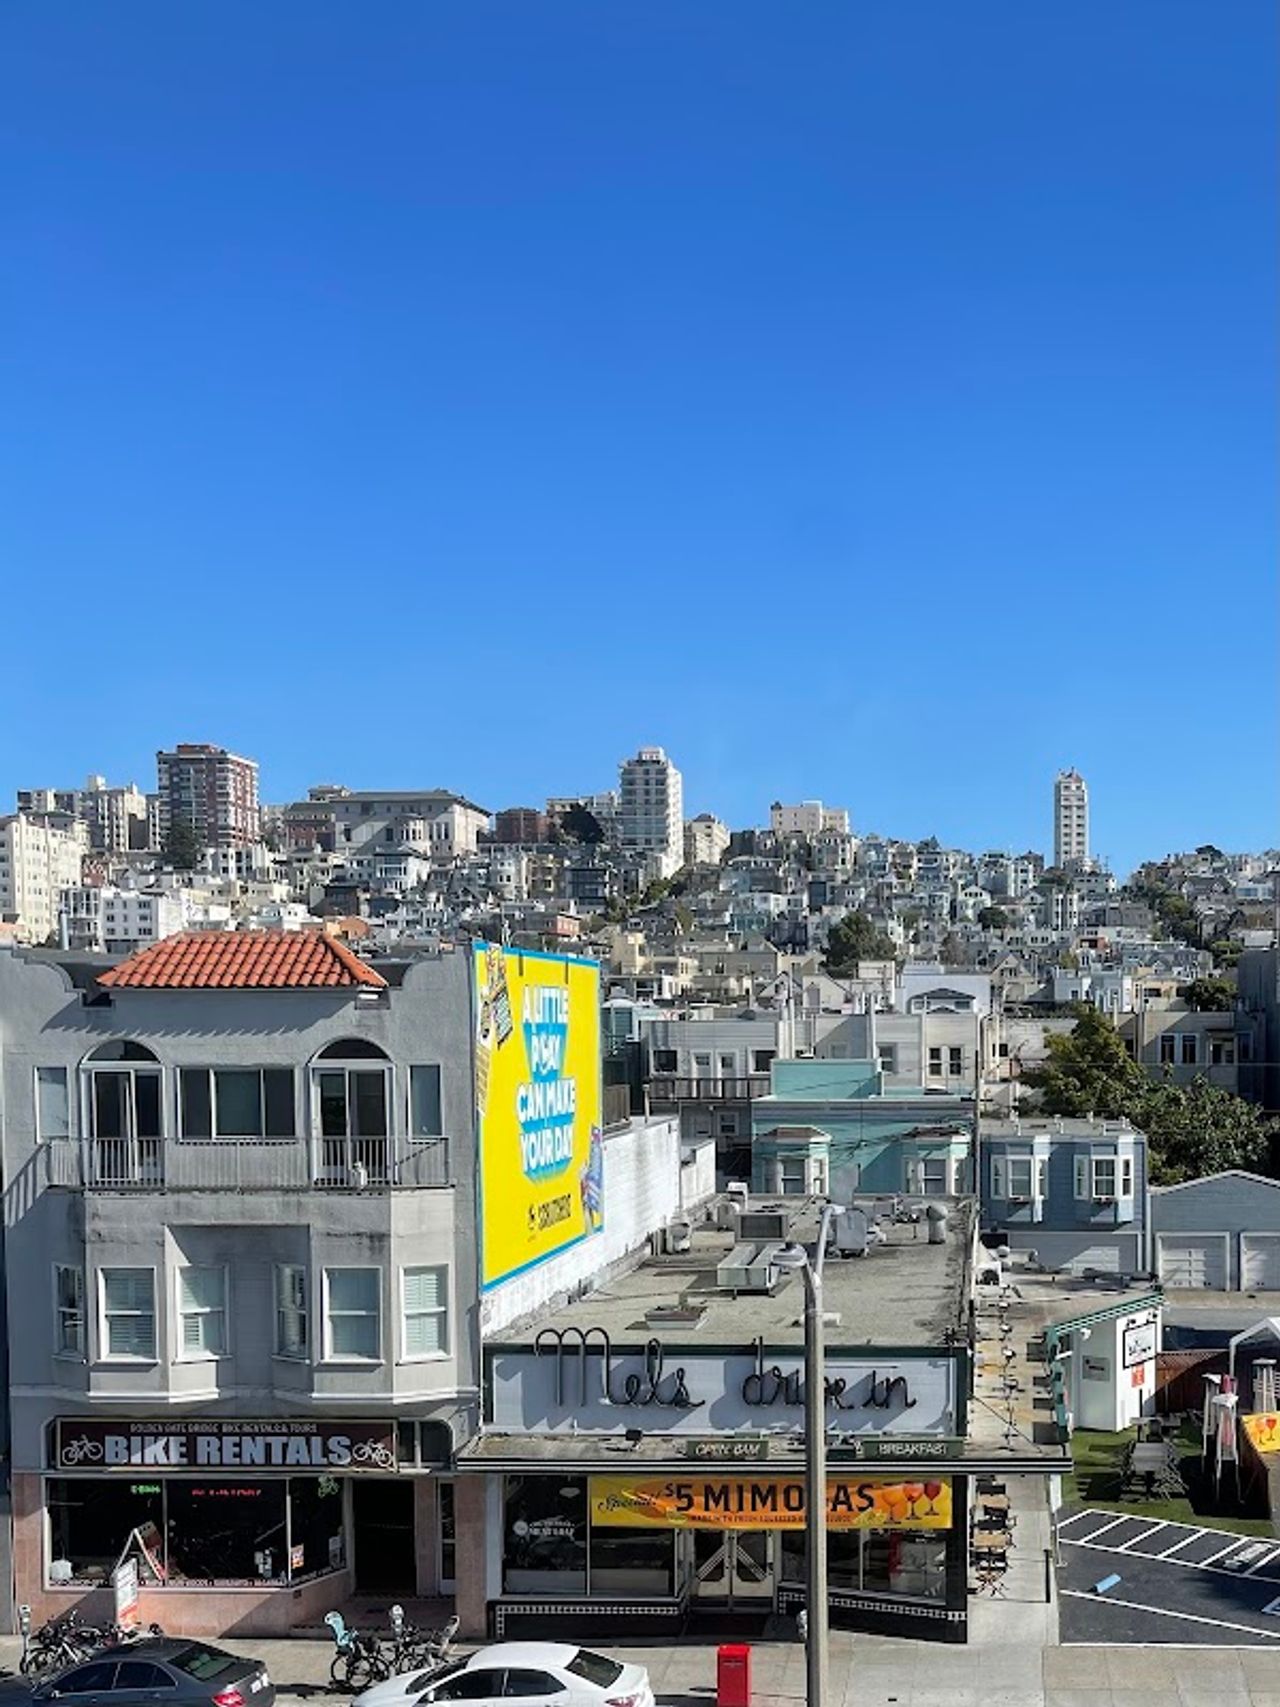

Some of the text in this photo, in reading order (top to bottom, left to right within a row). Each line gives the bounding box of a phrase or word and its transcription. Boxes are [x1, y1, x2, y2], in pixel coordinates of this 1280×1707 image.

[532, 985, 569, 1023] LITTLE
[516, 1077, 576, 1123] CAN MAKE
[519, 1125, 573, 1171] YOUR DAY
[535, 1327, 706, 1408] Mels
[742, 1335, 855, 1410] drie
[105, 1435, 352, 1464] BIKE RENTALS
[879, 1443, 947, 1455] BREAKFAST
[703, 1483, 875, 1512] MIMOAS
